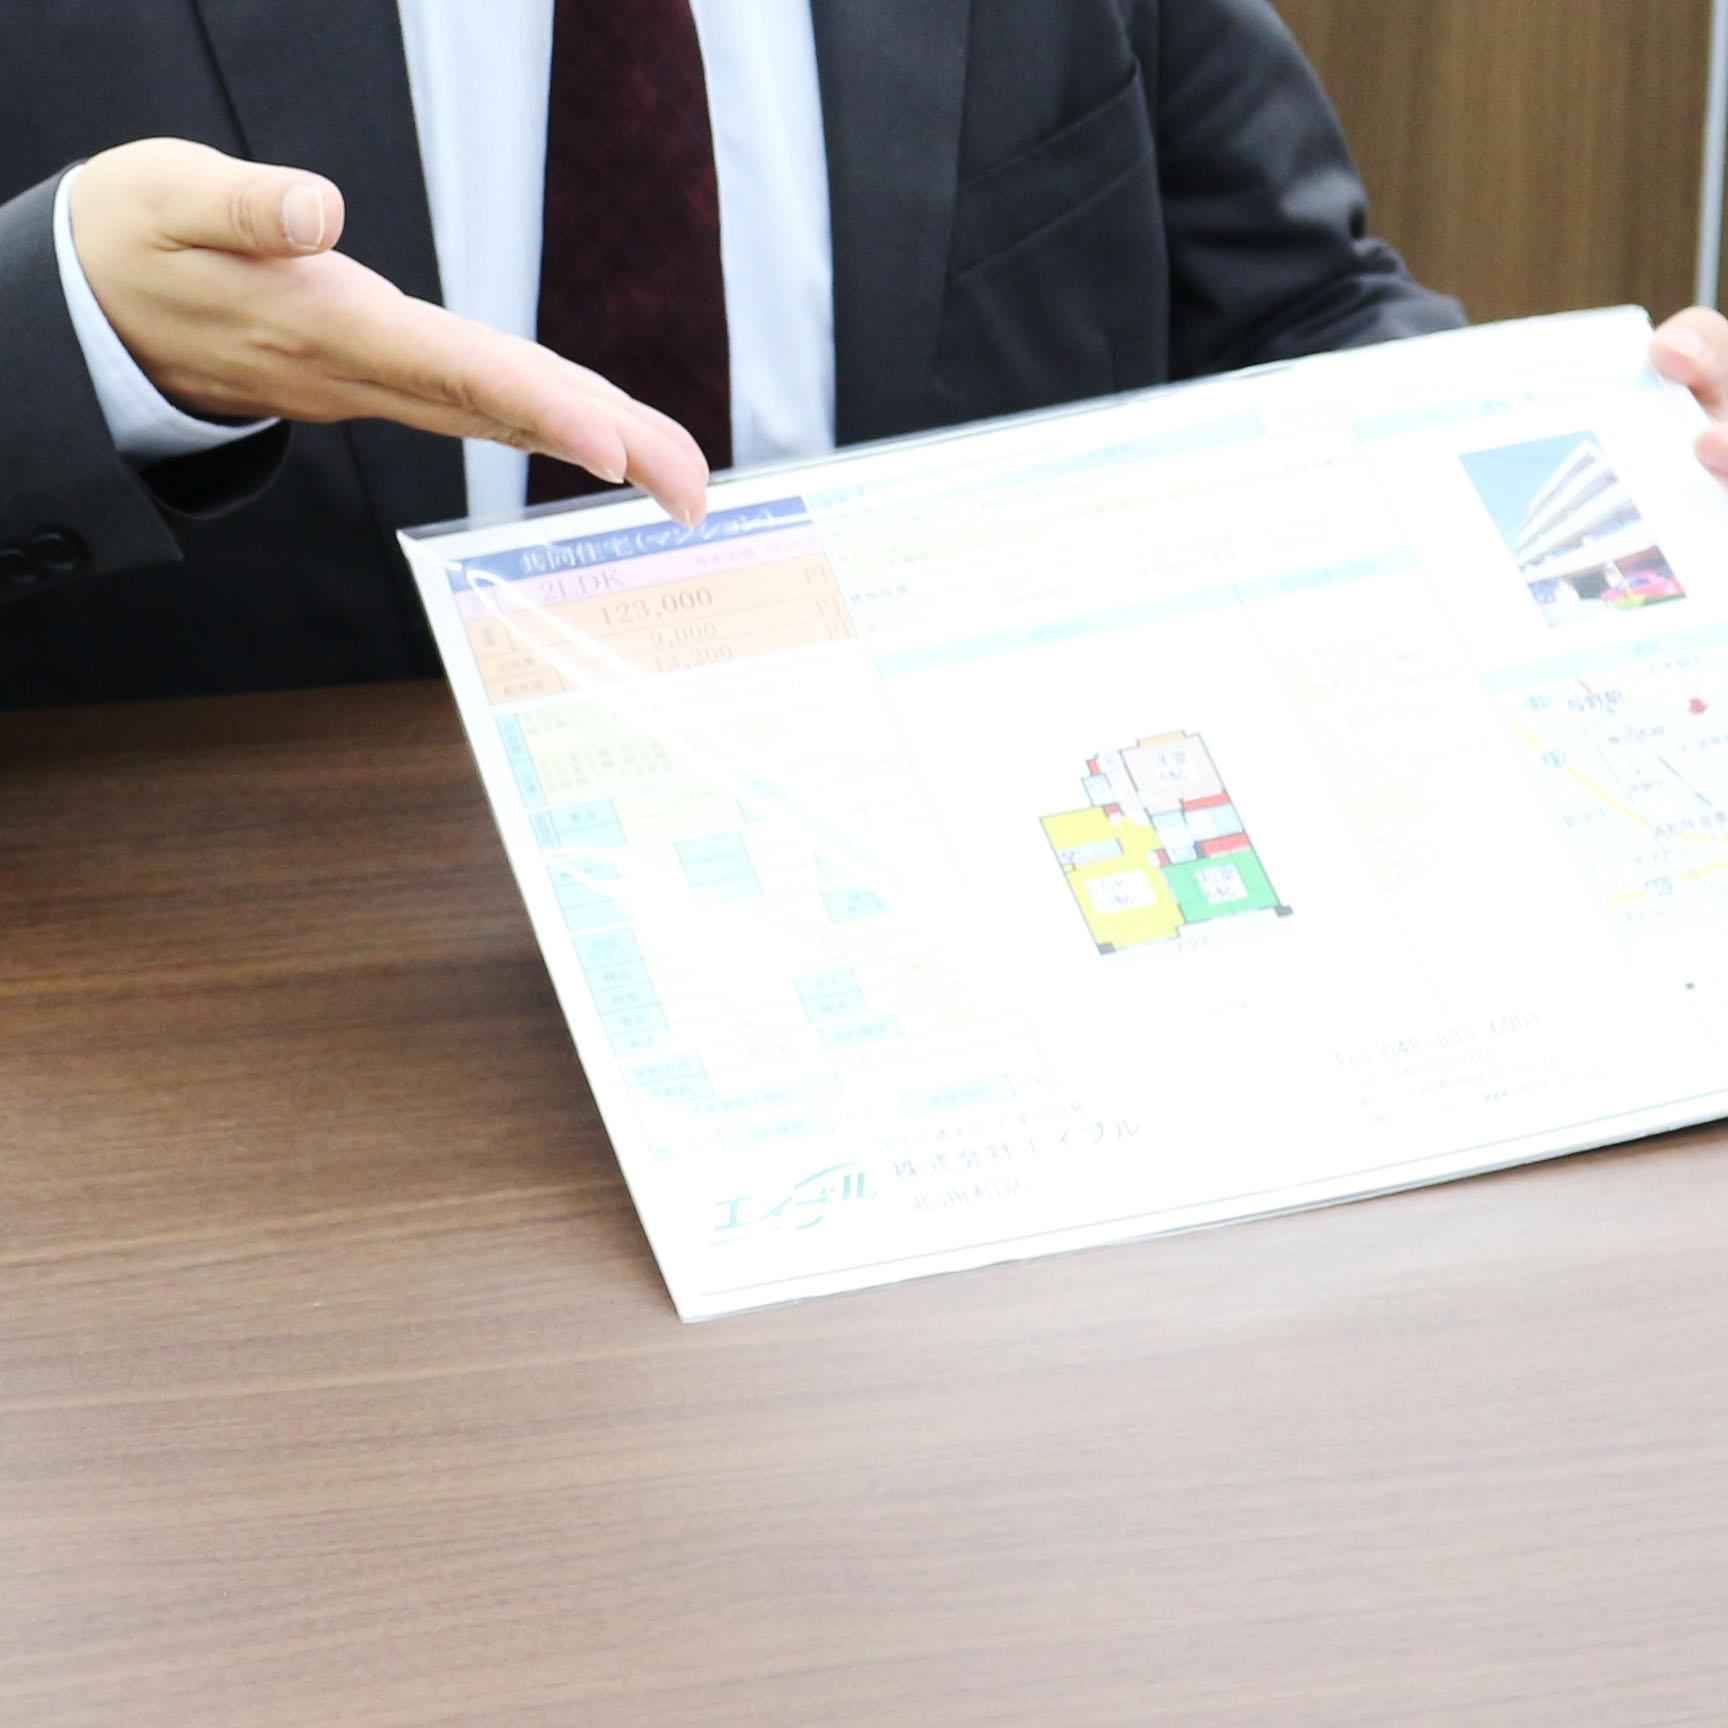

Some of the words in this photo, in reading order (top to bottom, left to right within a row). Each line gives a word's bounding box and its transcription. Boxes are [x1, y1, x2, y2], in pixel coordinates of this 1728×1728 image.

[540, 567, 627, 603] 2LDK
[599, 587, 716, 628] 123,000
[649, 622, 719, 651] 9,000
